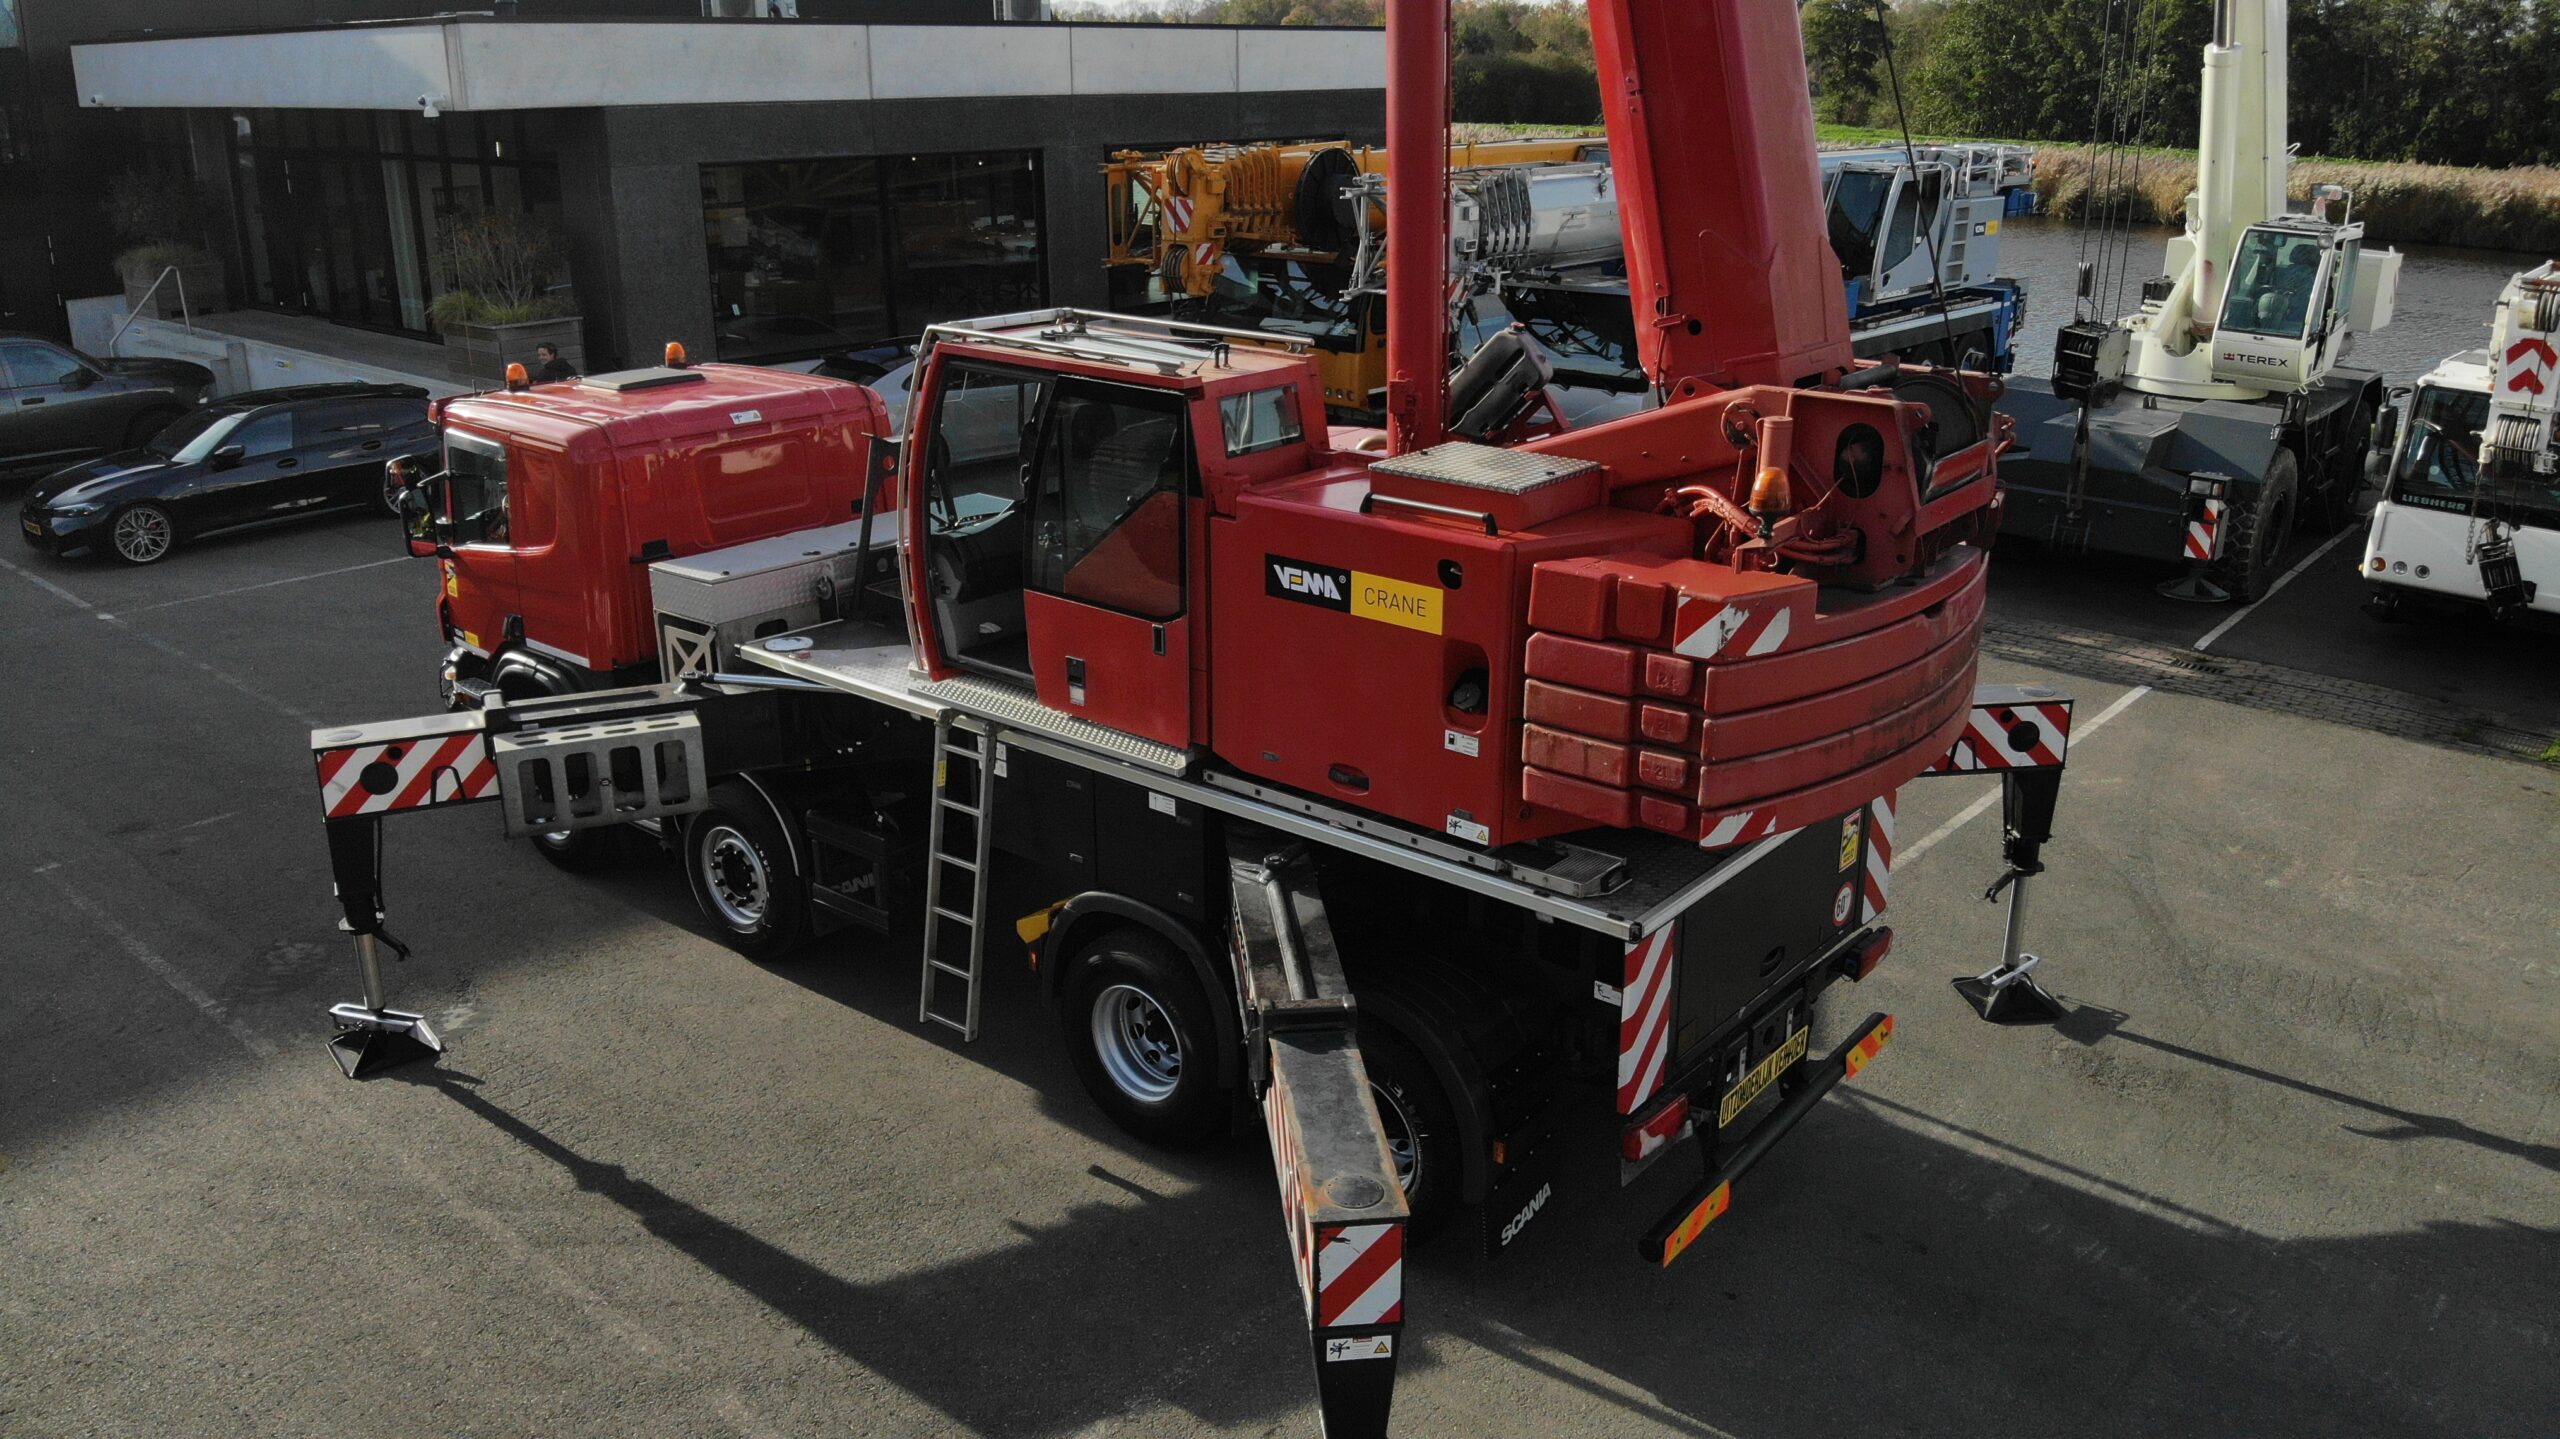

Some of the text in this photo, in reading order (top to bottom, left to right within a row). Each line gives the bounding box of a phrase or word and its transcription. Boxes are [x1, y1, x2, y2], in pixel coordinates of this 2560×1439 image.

[2237, 353, 2288, 368] TEREX
[2402, 494, 2466, 511] LIEBHERR
[1364, 587, 1426, 617] CRANE
[1836, 895, 1846, 917] 60
[1501, 1182, 1551, 1246] SCANIA
